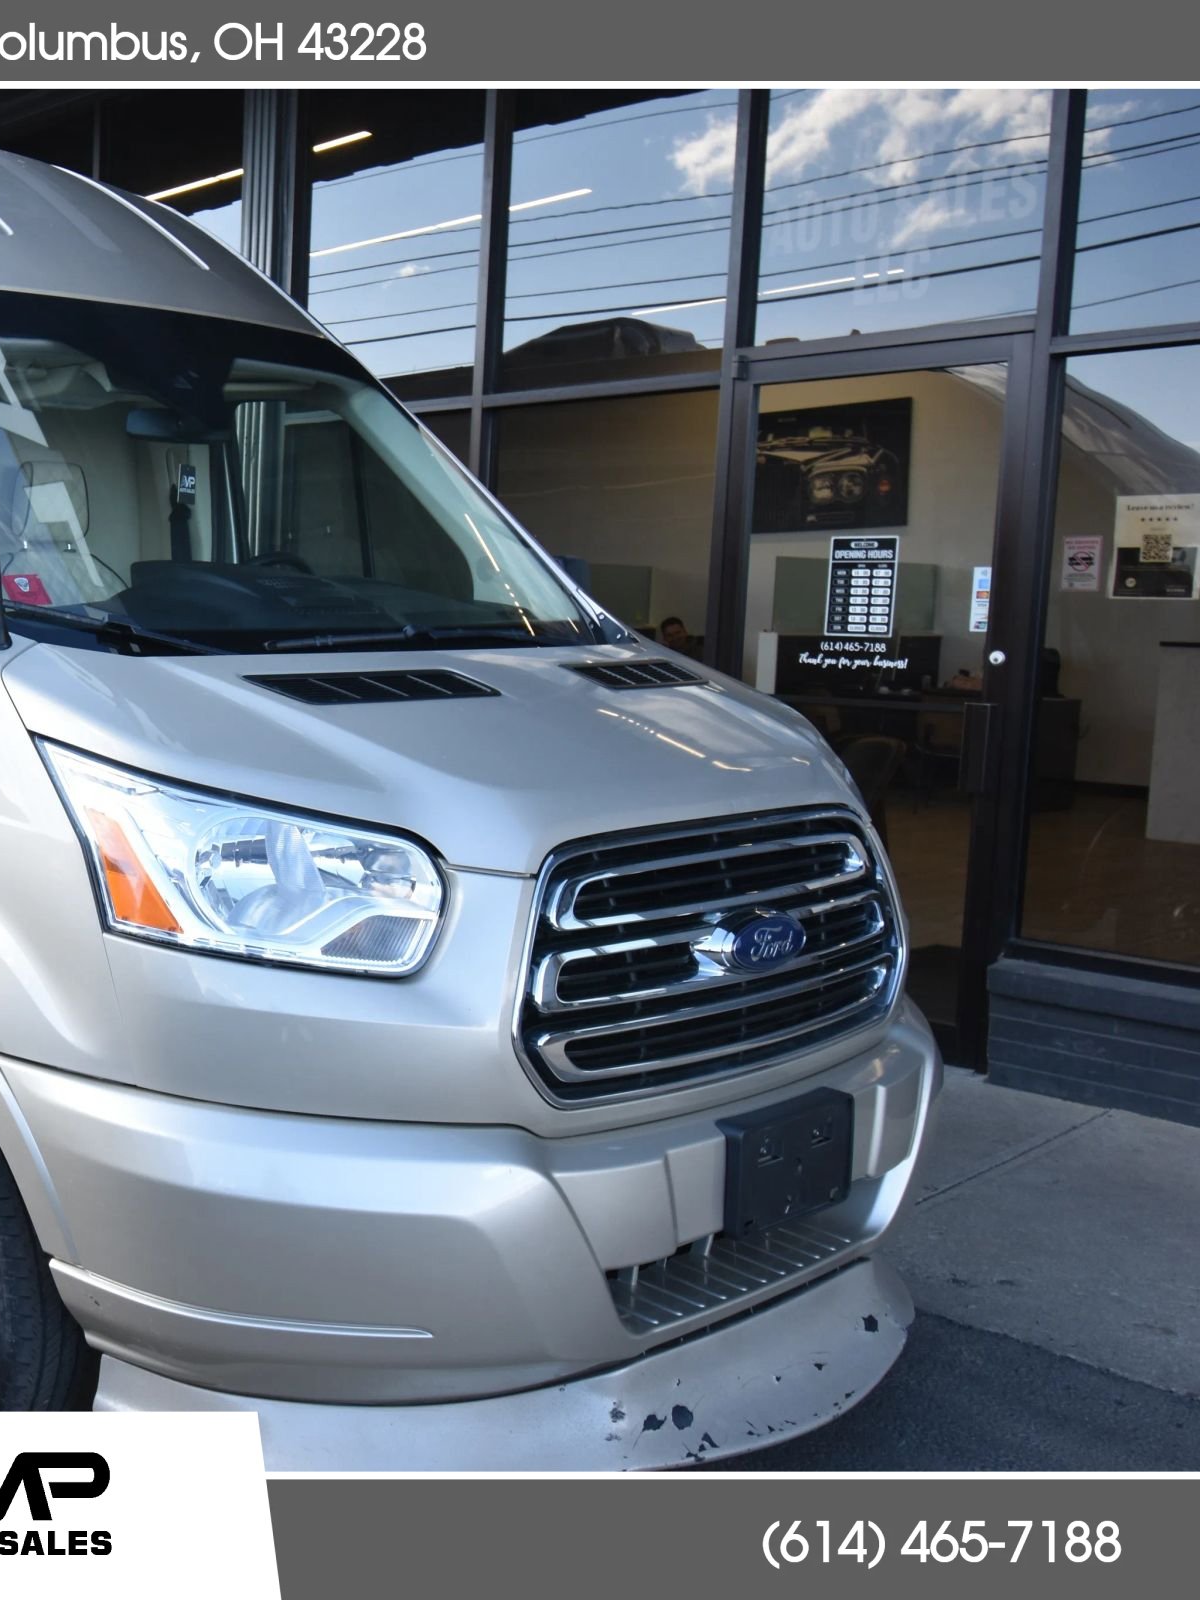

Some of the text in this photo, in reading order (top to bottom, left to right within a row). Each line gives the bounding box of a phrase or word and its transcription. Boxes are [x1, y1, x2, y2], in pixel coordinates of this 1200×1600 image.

[834, 550, 893, 560] OPENING HOURS
[798, 652, 908, 669] Thank you for your business!
[750, 926, 795, 964] Ford
